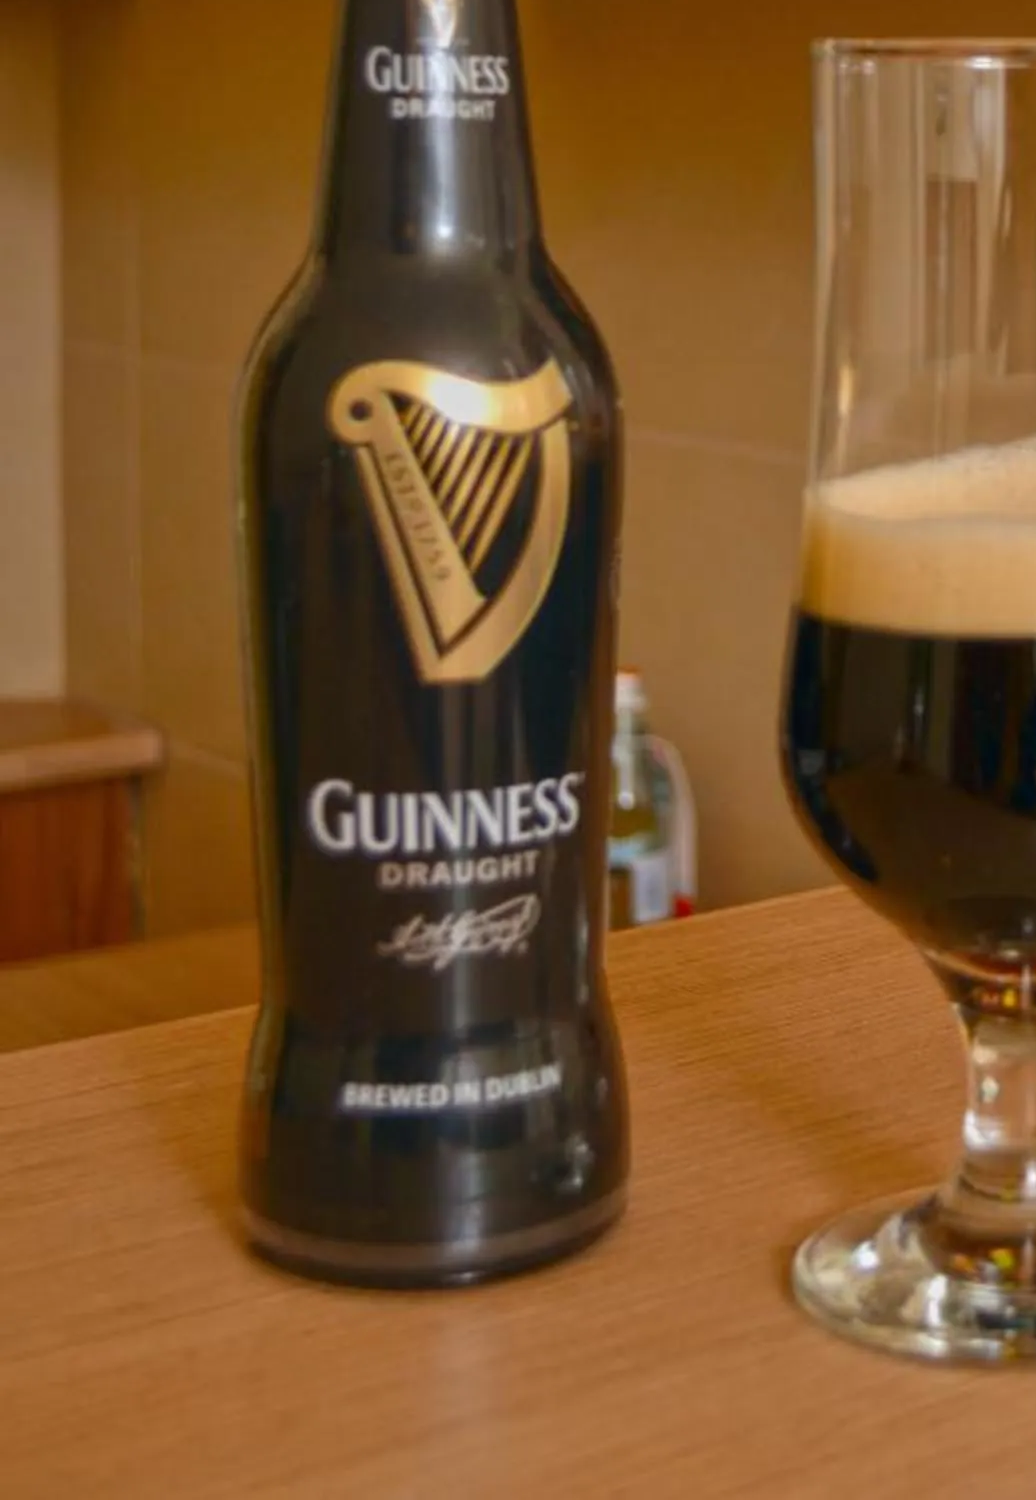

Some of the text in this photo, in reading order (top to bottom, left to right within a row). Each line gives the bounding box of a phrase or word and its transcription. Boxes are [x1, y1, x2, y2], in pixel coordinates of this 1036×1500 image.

[366, 46, 510, 95] GUINNESS
[391, 98, 496, 121] DRAUGHT
[309, 773, 585, 852] GUINNESS
[380, 850, 540, 889] DRAUGHT
[343, 1062, 562, 1109] BREWED IN DUBLIN
